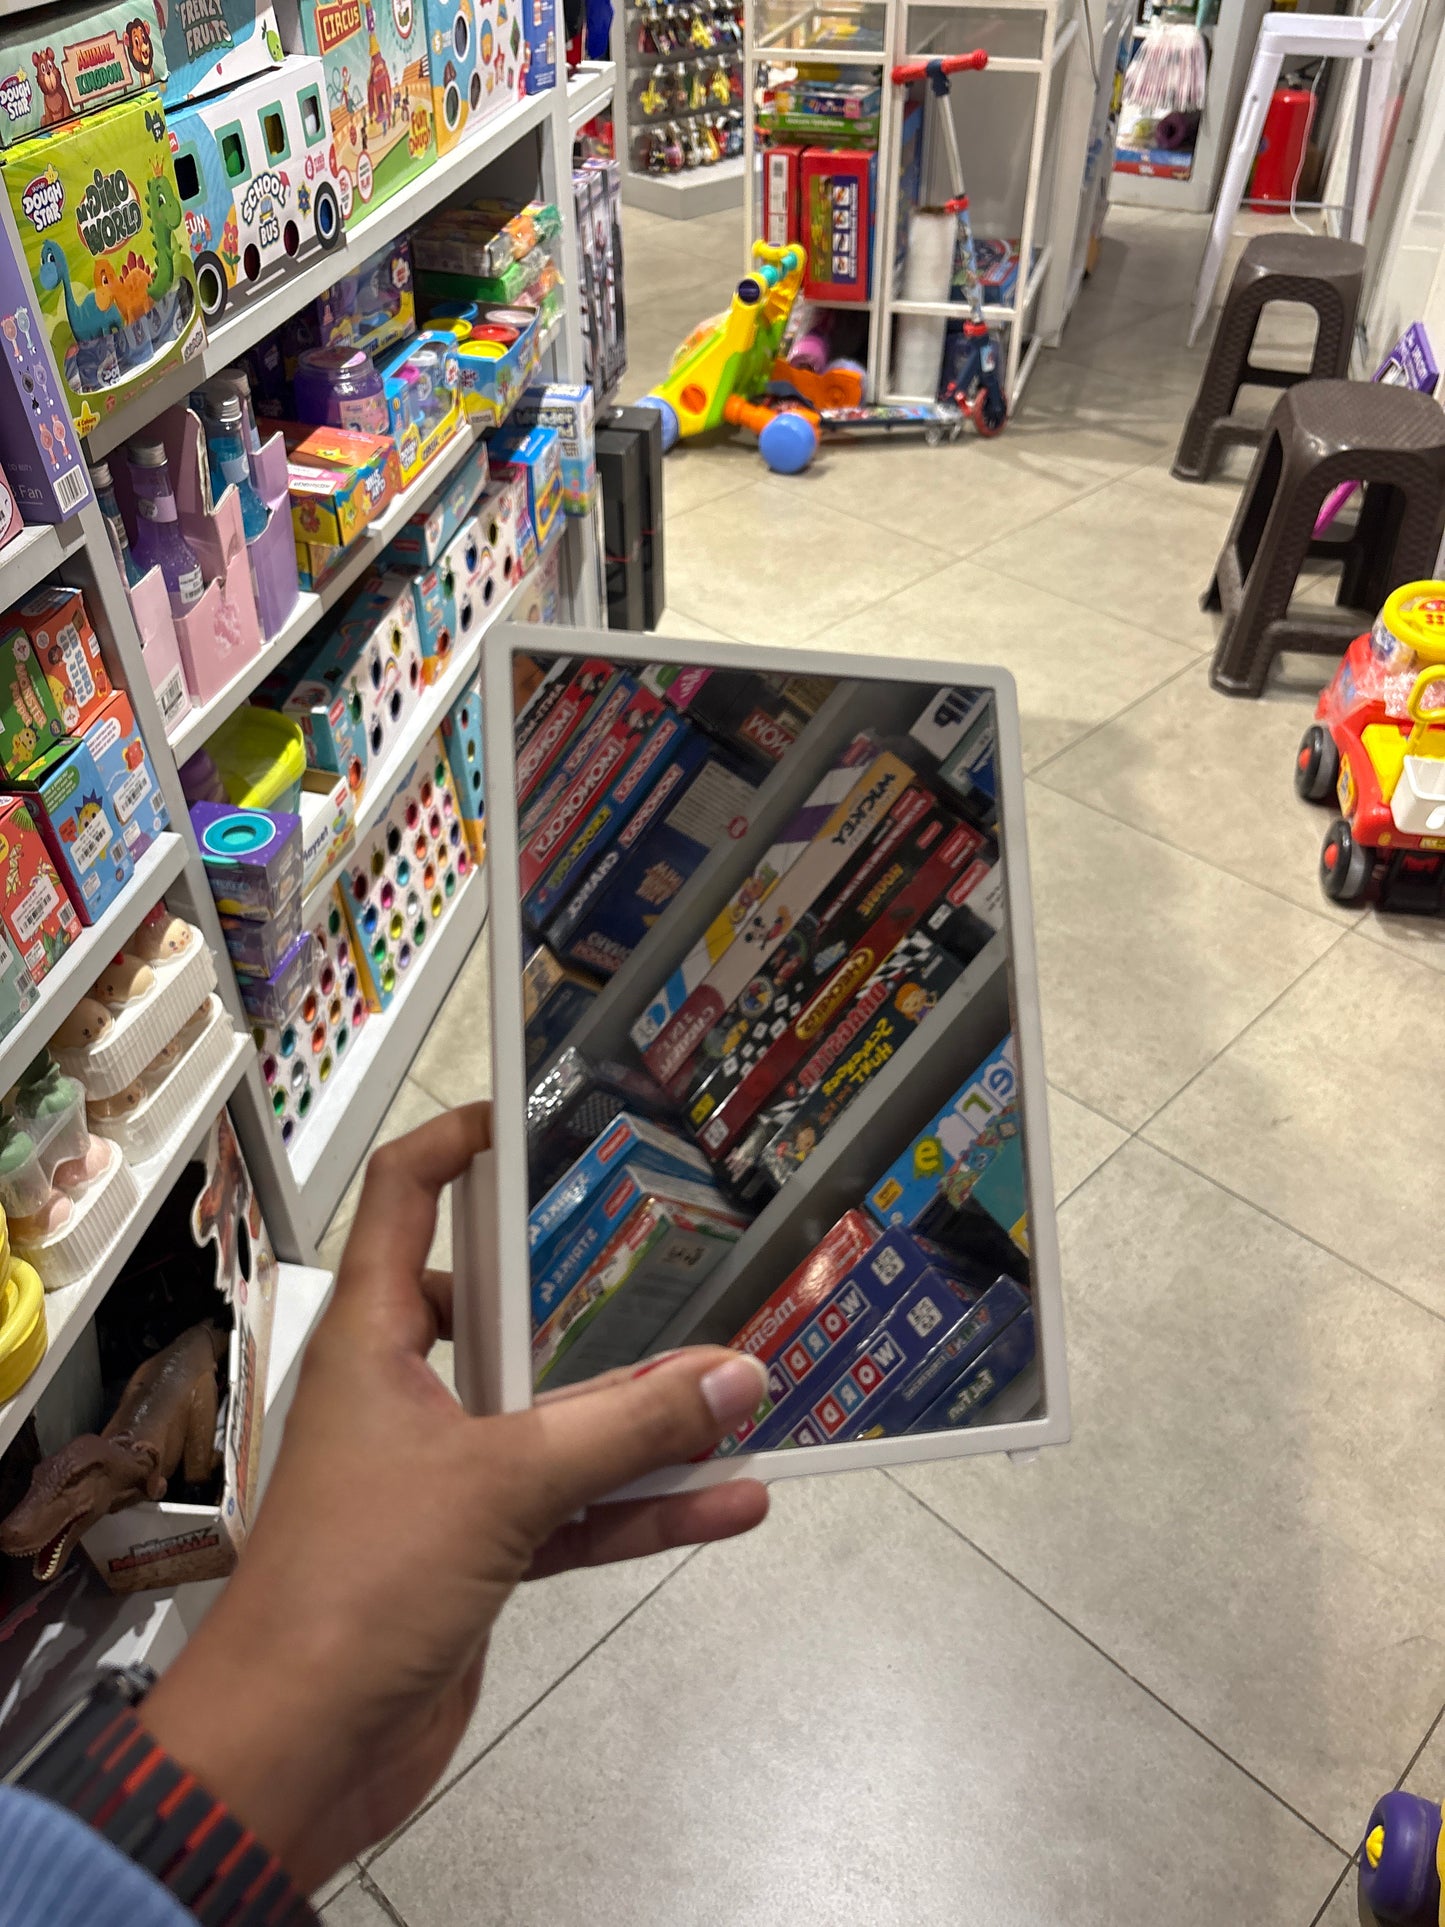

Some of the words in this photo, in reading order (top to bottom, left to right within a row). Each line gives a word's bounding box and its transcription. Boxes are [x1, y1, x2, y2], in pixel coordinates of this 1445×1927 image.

[185, 19, 232, 57] FRUITS
[322, 6, 360, 42] CIRCUS
[75, 62, 125, 95] KINGDOM
[8, 98, 31, 121] STAR
[22, 181, 63, 214] DOUGH
[241, 174, 286, 224] SCHOOL
[33, 203, 62, 231] STAR
[83, 200, 143, 256] WORLD
[185, 215, 206, 236] FUN
[259, 217, 280, 248] BUS
[19, 485, 43, 500] Fan
[15, 662, 47, 730] MONSTER
